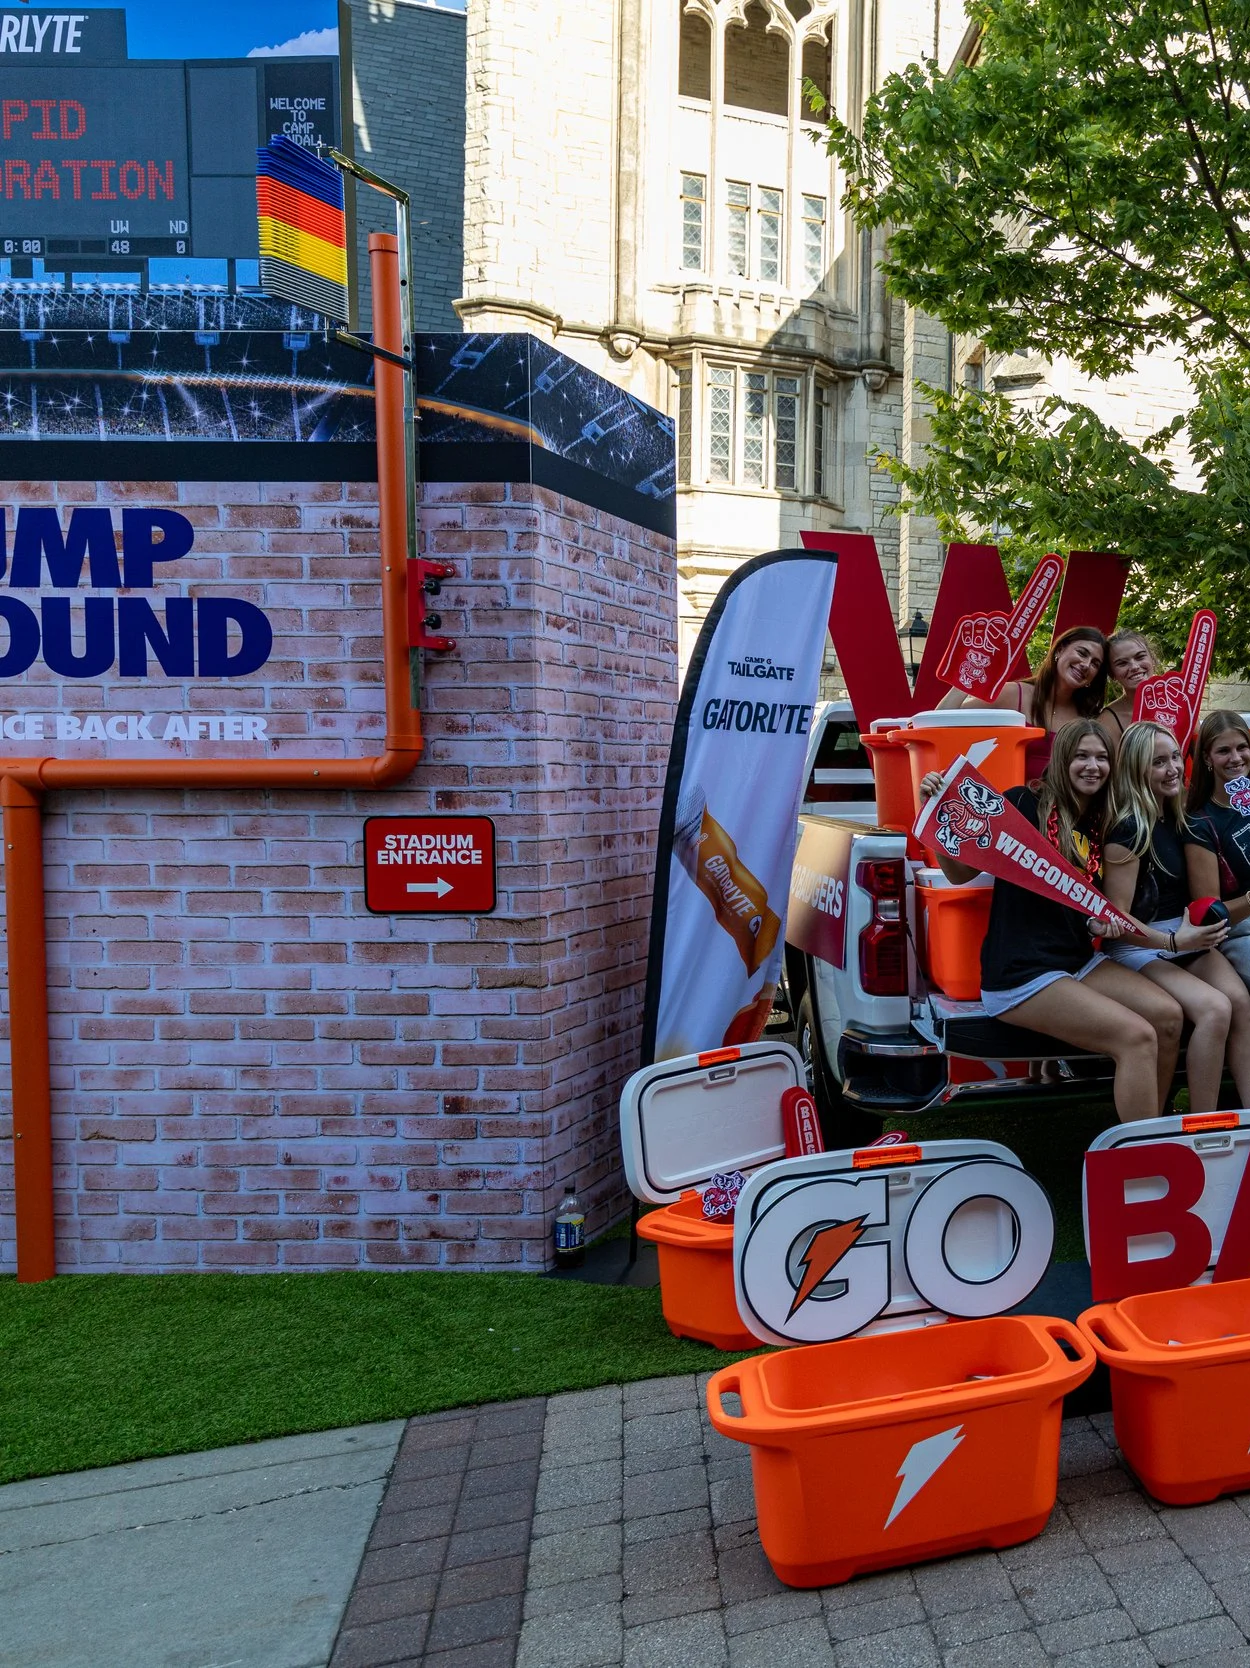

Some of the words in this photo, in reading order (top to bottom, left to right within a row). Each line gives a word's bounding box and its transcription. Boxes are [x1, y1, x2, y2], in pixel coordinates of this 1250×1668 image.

[0, 15, 84, 52] RLYTE
[3, 99, 86, 139] PID
[270, 97, 326, 110] WELCOME
[290, 110, 307, 122] TO
[282, 122, 315, 134] CAMP
[0, 160, 174, 199] RATION
[110, 220, 130, 234] UW
[169, 220, 188, 234] ND
[111, 240, 130, 254] 48
[176, 240, 186, 254] 0
[0, 508, 195, 588] MP
[1010, 565, 1055, 640] BADGERS
[728, 661, 795, 681] TAILGATE
[744, 656, 764, 665] CAMP
[1187, 622, 1211, 695] BADGERS
[0, 715, 45, 740] CE
[57, 716, 154, 740] BACK
[162, 716, 268, 740] AFTER
[702, 698, 812, 735] GATORLYTE
[377, 850, 483, 865] ENTRANCE
[384, 834, 473, 850] STADIUM
[704, 855, 756, 917] GATORLYTE
[995, 831, 1107, 916] WISCONSIN
[741, 1160, 1055, 1343] GO
